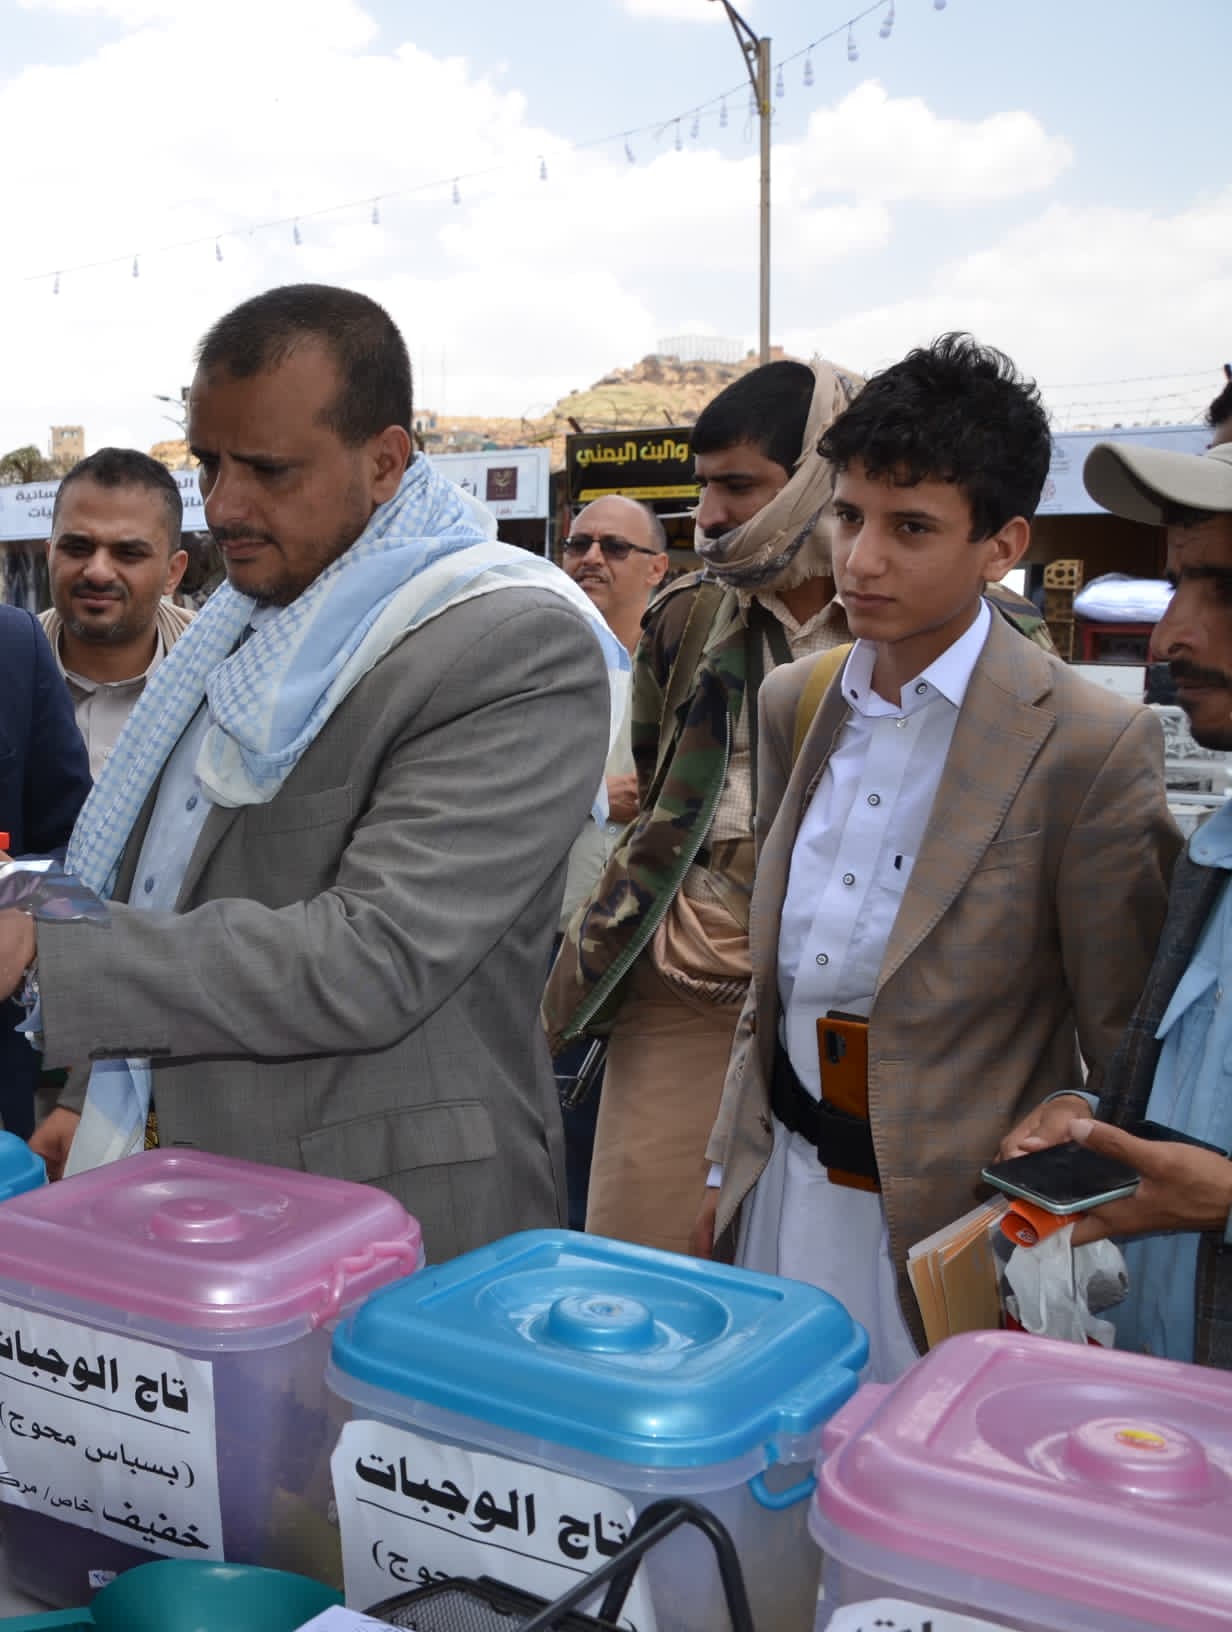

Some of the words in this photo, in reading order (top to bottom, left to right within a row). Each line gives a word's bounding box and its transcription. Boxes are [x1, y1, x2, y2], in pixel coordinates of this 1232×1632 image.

[576, 441, 637, 467] اليمني
[134, 1371, 190, 1413] تاج
[84, 1443, 196, 1489] (بسباس
[355, 1453, 536, 1537] الوجبات
[101, 1500, 211, 1551] خفيف
[557, 1512, 628, 1560] تاج
